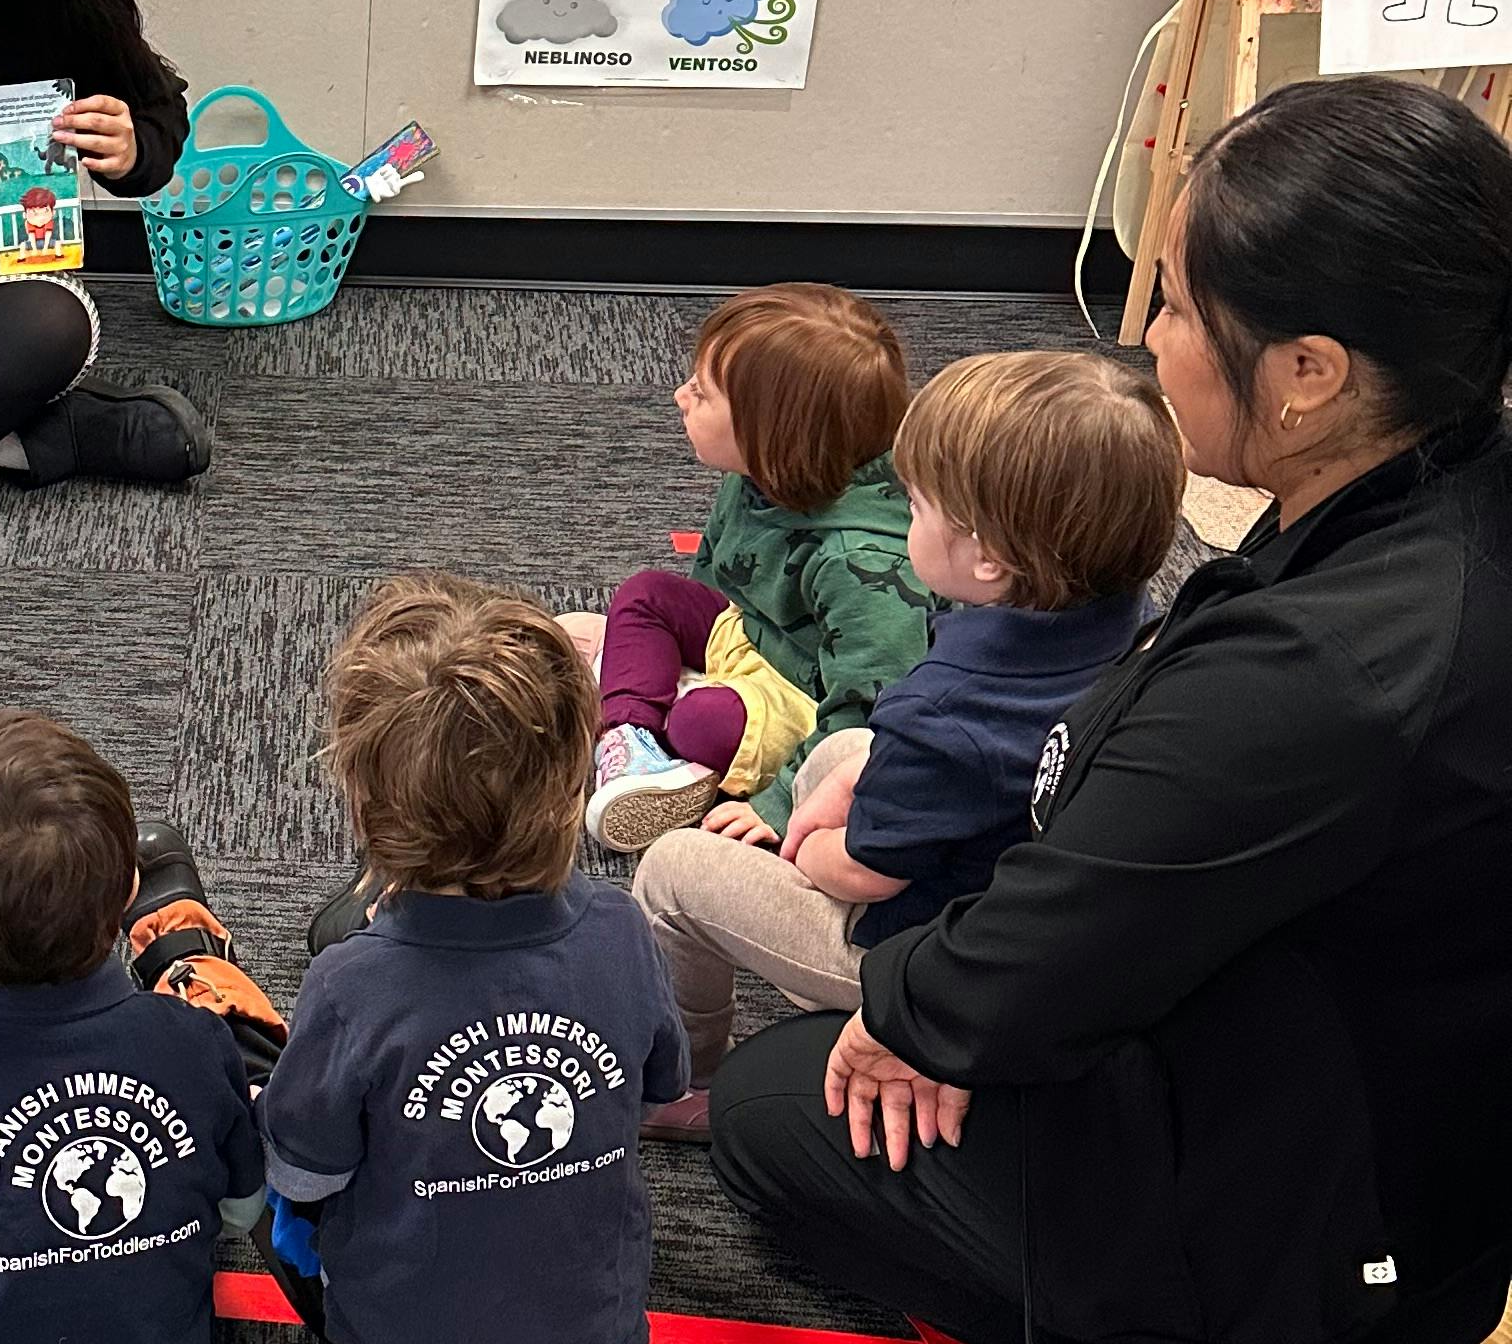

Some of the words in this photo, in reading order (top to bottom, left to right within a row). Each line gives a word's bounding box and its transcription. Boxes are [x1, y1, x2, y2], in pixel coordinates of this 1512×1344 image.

[524, 50, 633, 66] NEBLINOSO
[668, 57, 758, 72] VENTOSO
[403, 1021, 488, 1120] SPANISH
[496, 1012, 626, 1090] IMMERSION
[440, 1044, 596, 1121] MONTESSORI
[11, 1106, 169, 1189] MONTESSORI
[64, 1072, 196, 1159] IMMERSION
[414, 1146, 626, 1200] SpanishForToddlers.com
